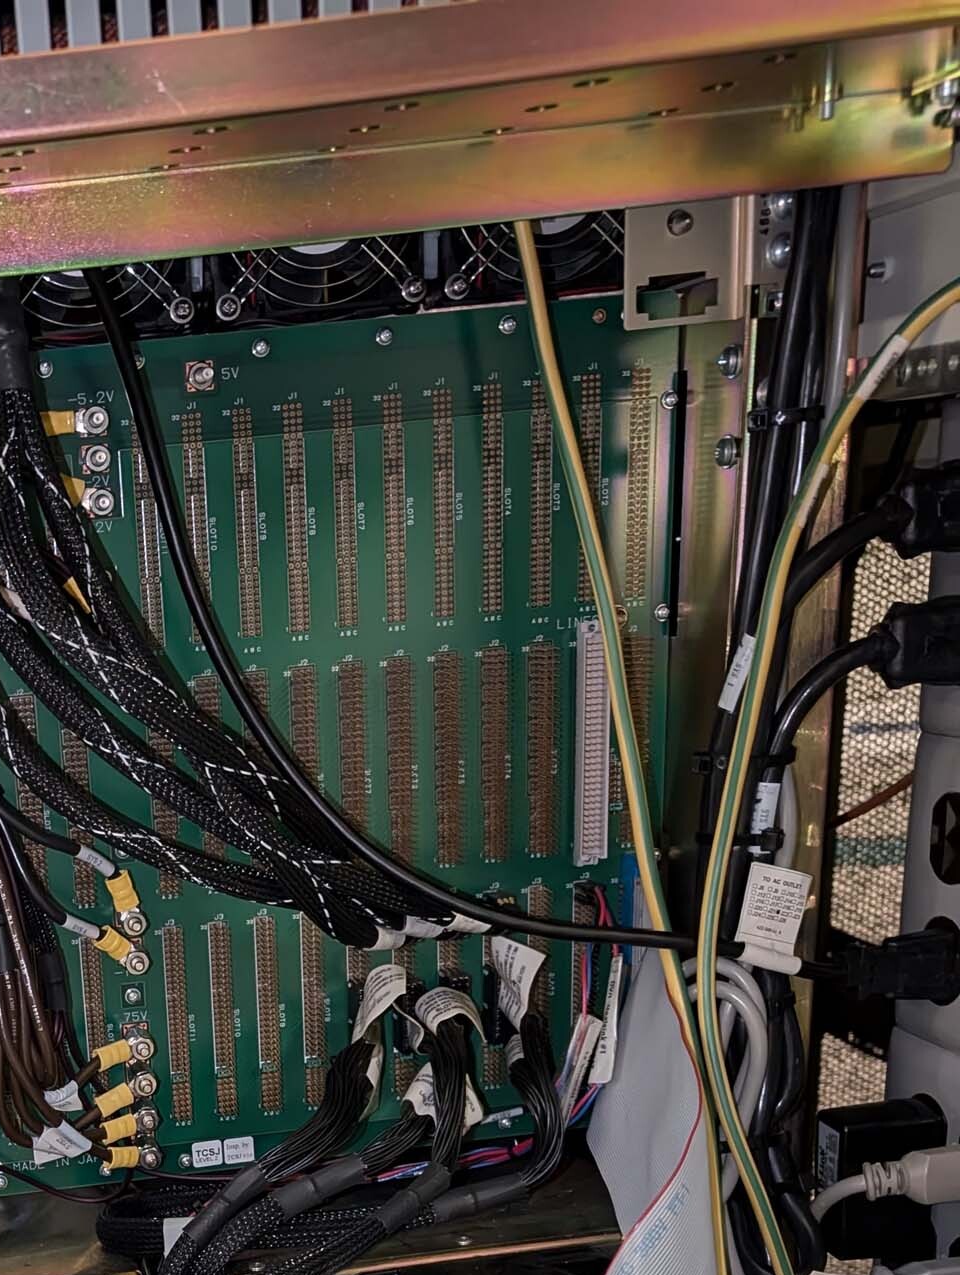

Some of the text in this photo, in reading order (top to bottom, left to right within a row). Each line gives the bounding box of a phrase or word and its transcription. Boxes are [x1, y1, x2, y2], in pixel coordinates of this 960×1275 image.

[221, 367, 240, 380] 5V
[68, 390, 115, 406] -5.2V
[195, 1147, 221, 1158] TCSJ
[55, 1157, 70, 1168] IN
